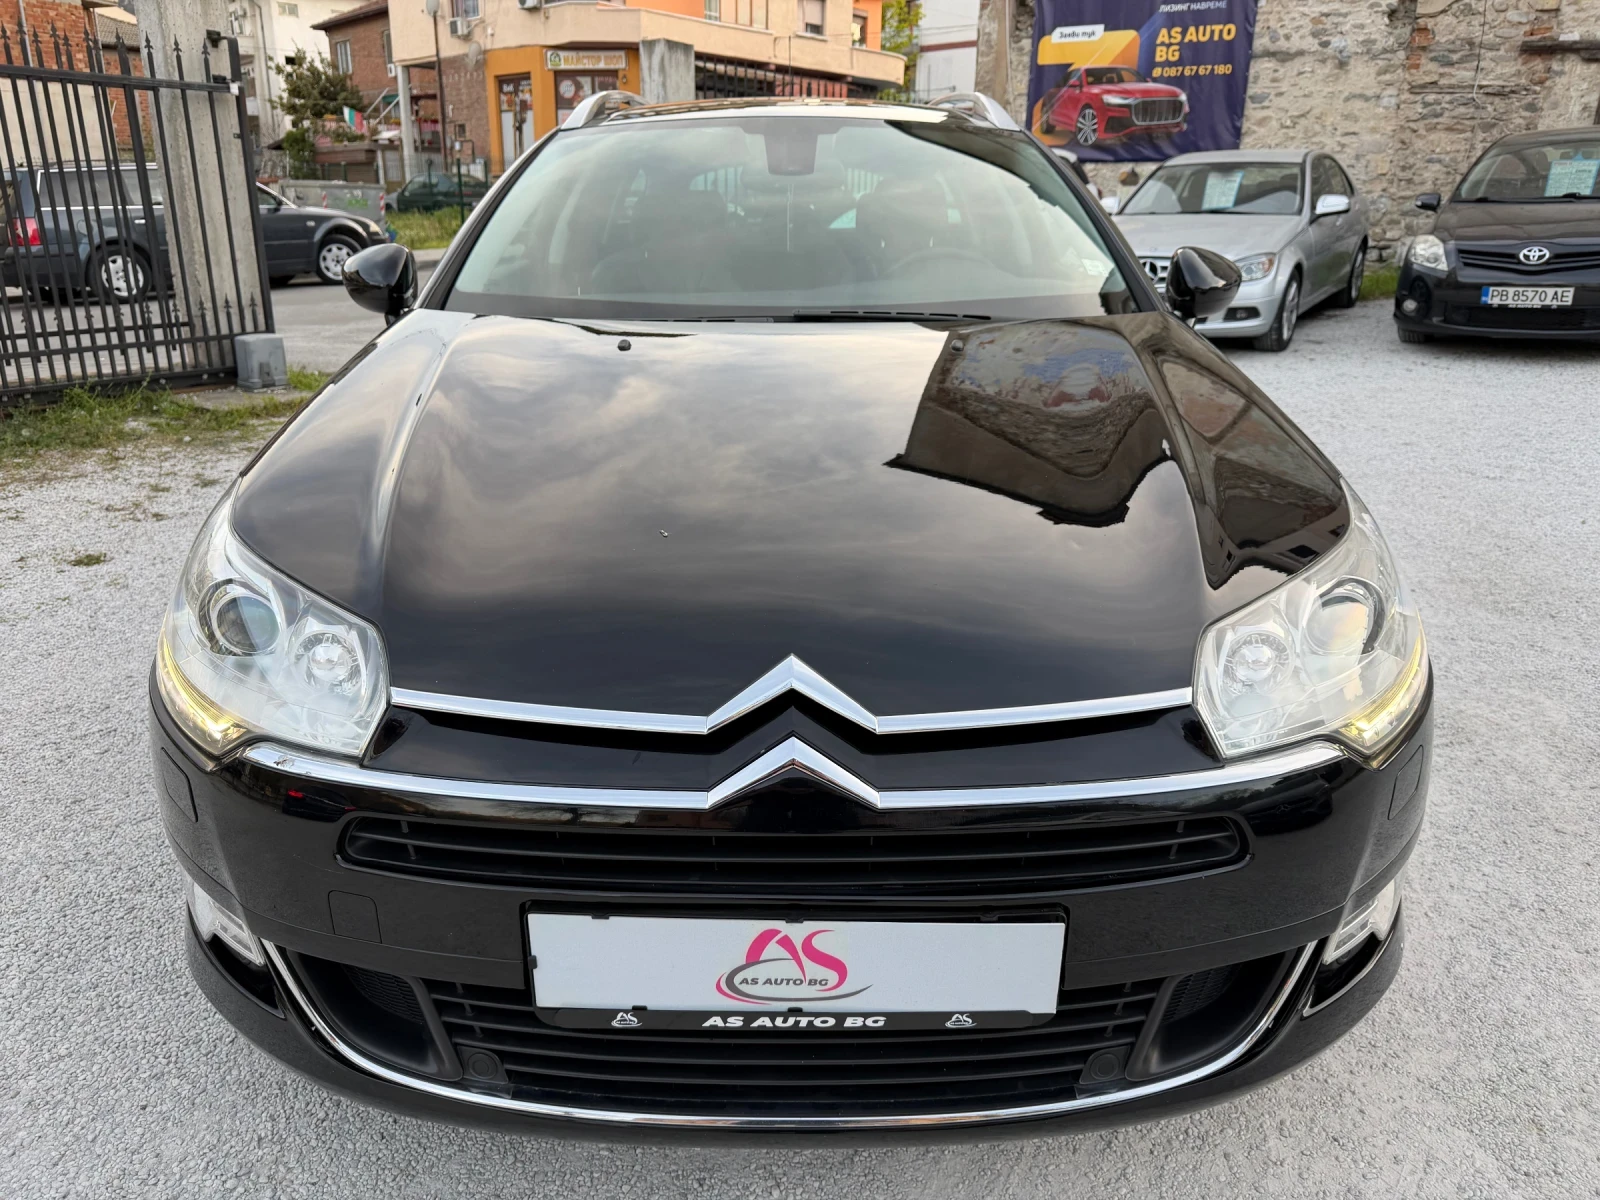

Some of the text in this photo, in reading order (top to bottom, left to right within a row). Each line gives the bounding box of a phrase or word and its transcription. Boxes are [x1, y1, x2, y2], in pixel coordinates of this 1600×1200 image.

[1159, 2, 1190, 13] ЛИЗИНГ
[1082, 29, 1097, 39] тук
[1156, 23, 1237, 44] AS AUTO
[563, 52, 624, 67] МАЙСТОР ШОП
[1155, 45, 1180, 62] BG
[1163, 64, 1233, 77] 087 67 67 180
[1490, 289, 1571, 303] PB 8570 AE
[745, 928, 848, 992] AS
[738, 977, 830, 987] AS AUTO BG
[701, 1016, 888, 1028] AS AUTO BG
